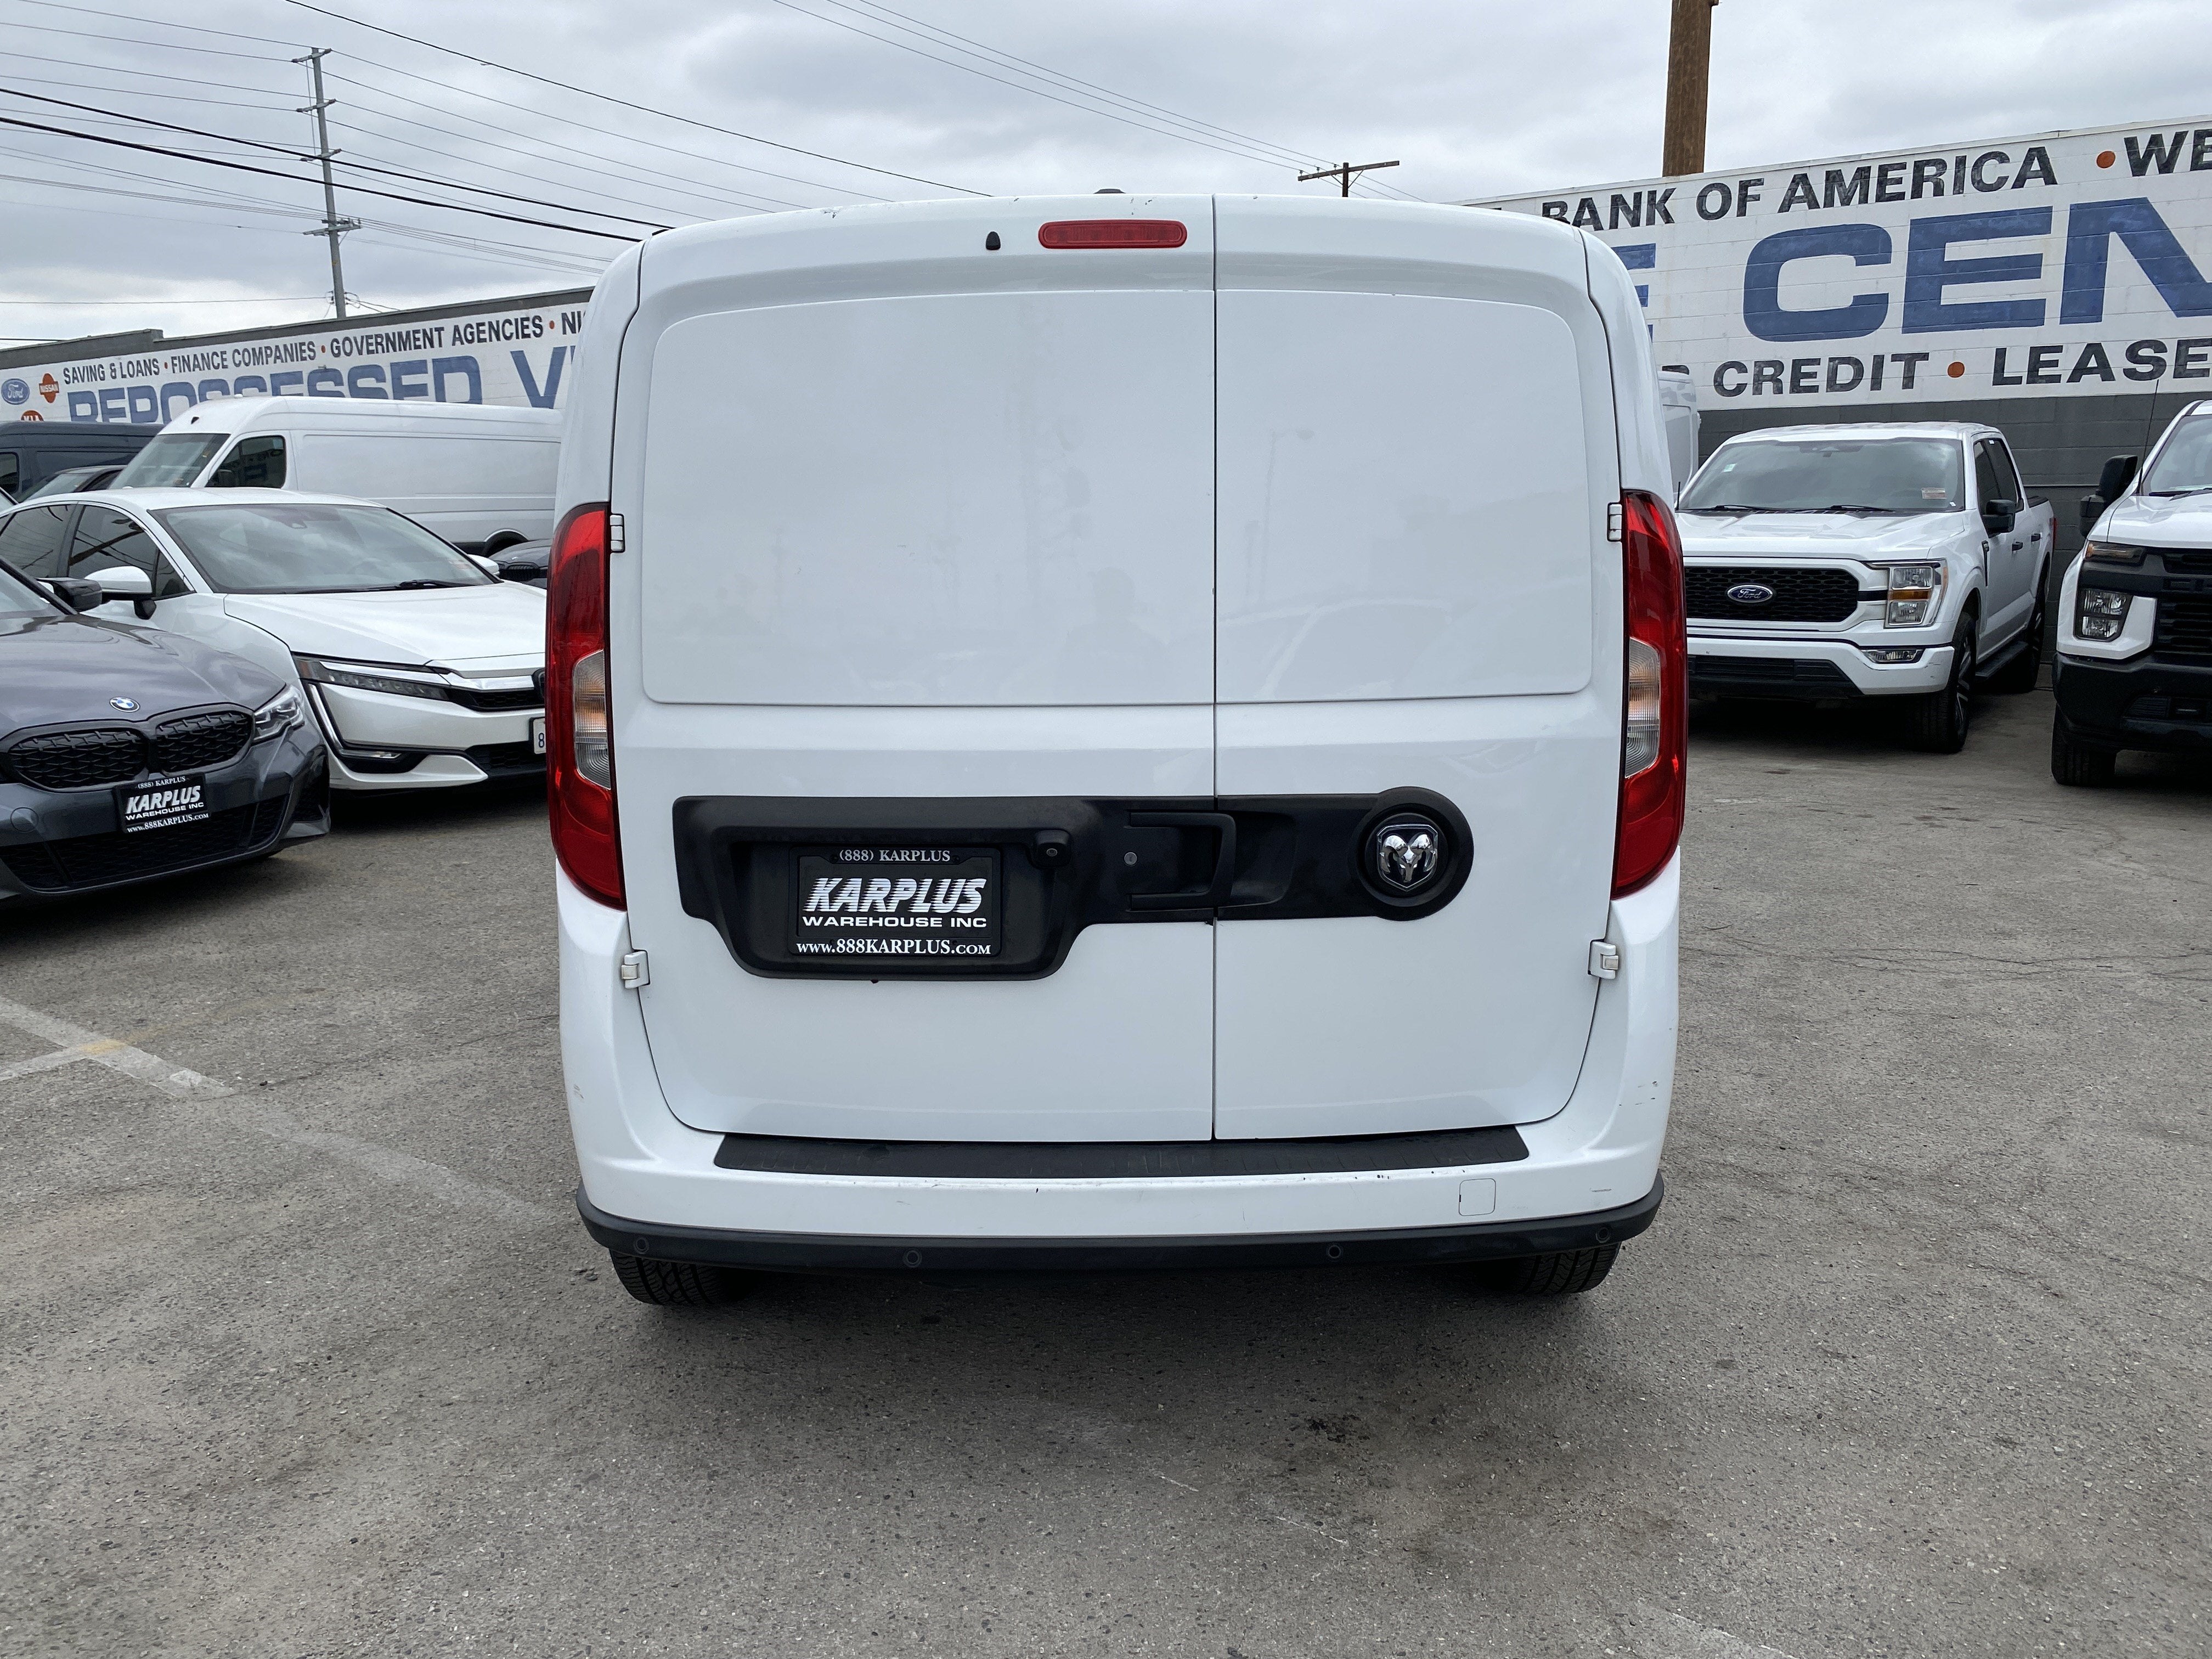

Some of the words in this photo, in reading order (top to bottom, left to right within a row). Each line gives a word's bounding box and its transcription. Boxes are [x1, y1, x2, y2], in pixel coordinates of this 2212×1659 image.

[1542, 187, 1677, 231] BANK
[1696, 178, 1764, 220] OF
[1778, 146, 2058, 213] AMERICA
[1743, 196, 2212, 342] CEN
[330, 327, 444, 358] GOVERNMENT
[452, 315, 543, 346] AGENCIES
[63, 364, 105, 385] SAVING
[110, 364, 117, 380] &
[120, 358, 160, 379] LOANS
[171, 350, 229, 374] FINANCE
[232, 341, 317, 368] COMPANIES
[1713, 352, 1929, 397] CREDIT
[7, 384, 24, 398] Ford
[1737, 588, 1762, 599] Ford
[155, 776, 186, 786] KARPLUS
[125, 785, 201, 814] KARPLUS
[126, 805, 187, 821] WAREHOUSE
[839, 850, 874, 862] (888)
[879, 850, 951, 862] KARPLUS
[802, 878, 987, 914] KARPLUS
[802, 916, 943, 927] WAREHOUSE
[950, 917, 987, 928] INC
